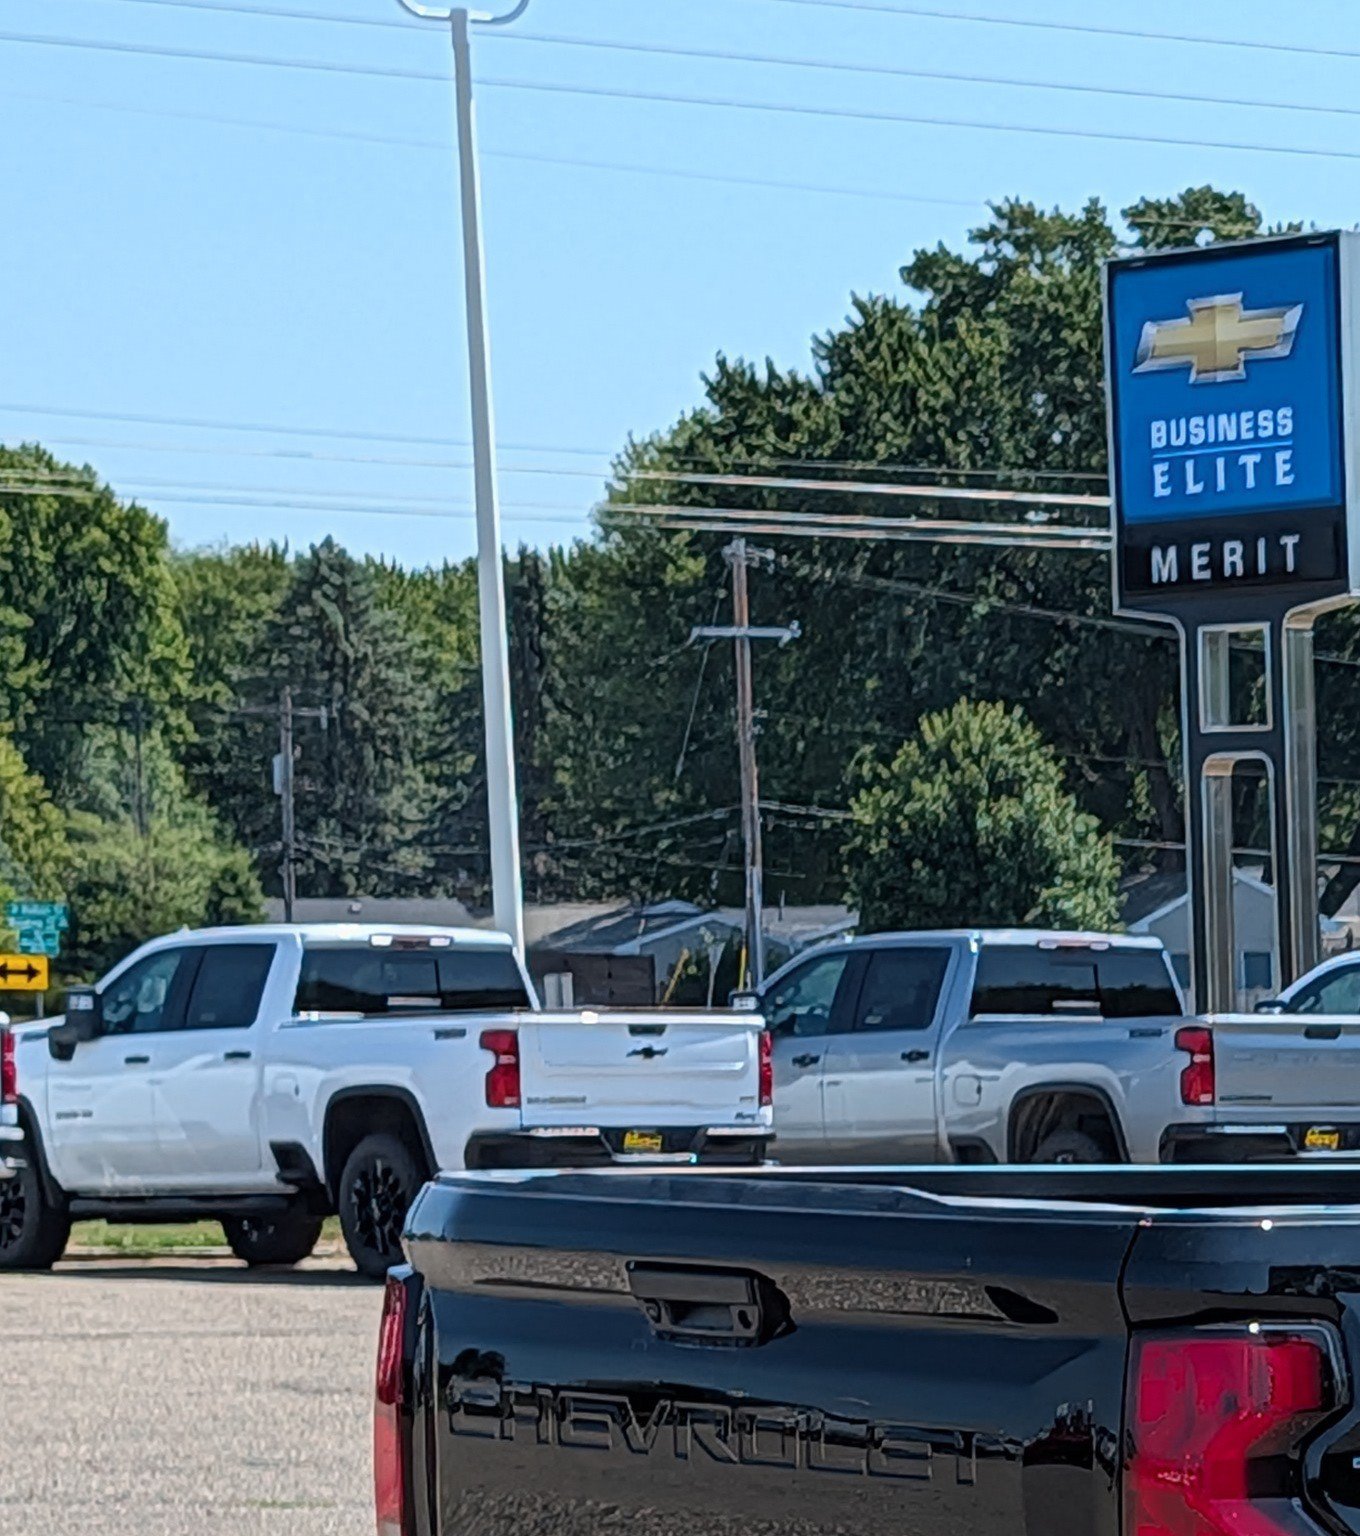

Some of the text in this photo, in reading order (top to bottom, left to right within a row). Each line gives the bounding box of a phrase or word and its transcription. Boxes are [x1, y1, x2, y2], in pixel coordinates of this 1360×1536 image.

[1151, 407, 1293, 449] BUSINESS
[1153, 449, 1296, 498] ELITE
[1151, 534, 1300, 584] MERIT
[446, 1374, 1010, 1487] CHEVROLET
